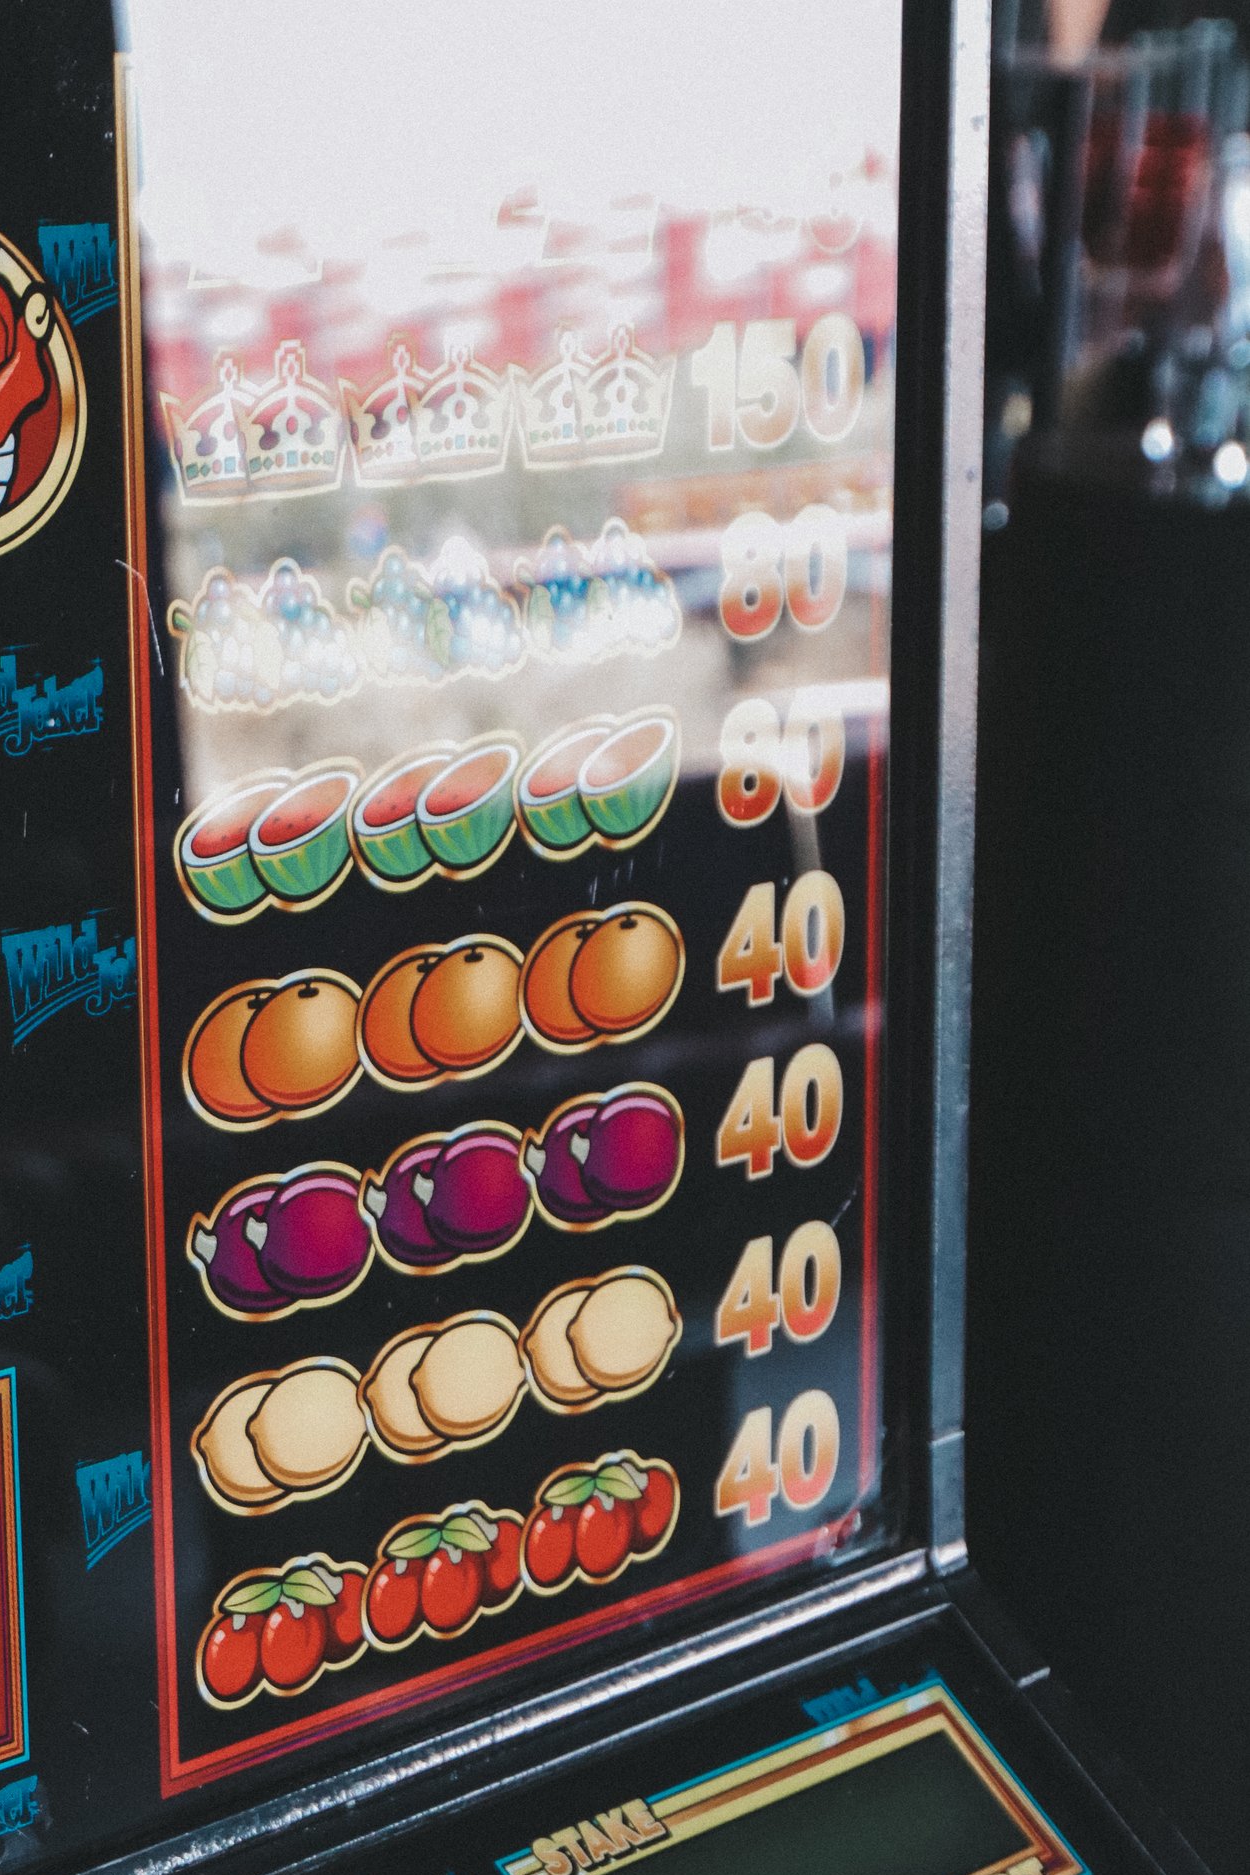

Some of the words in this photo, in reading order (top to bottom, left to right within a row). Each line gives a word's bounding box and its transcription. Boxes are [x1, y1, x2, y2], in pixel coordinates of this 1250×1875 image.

[38, 222, 118, 306] Wil
[689, 313, 865, 453] 150
[717, 502, 846, 641] 80
[4, 665, 104, 757] Joker
[1, 918, 100, 1022] Wild
[716, 869, 845, 1007] 40
[716, 1042, 844, 1181] 40
[716, 1219, 842, 1358] 40
[75, 1450, 152, 1549] Wil
[716, 1388, 841, 1526] 40
